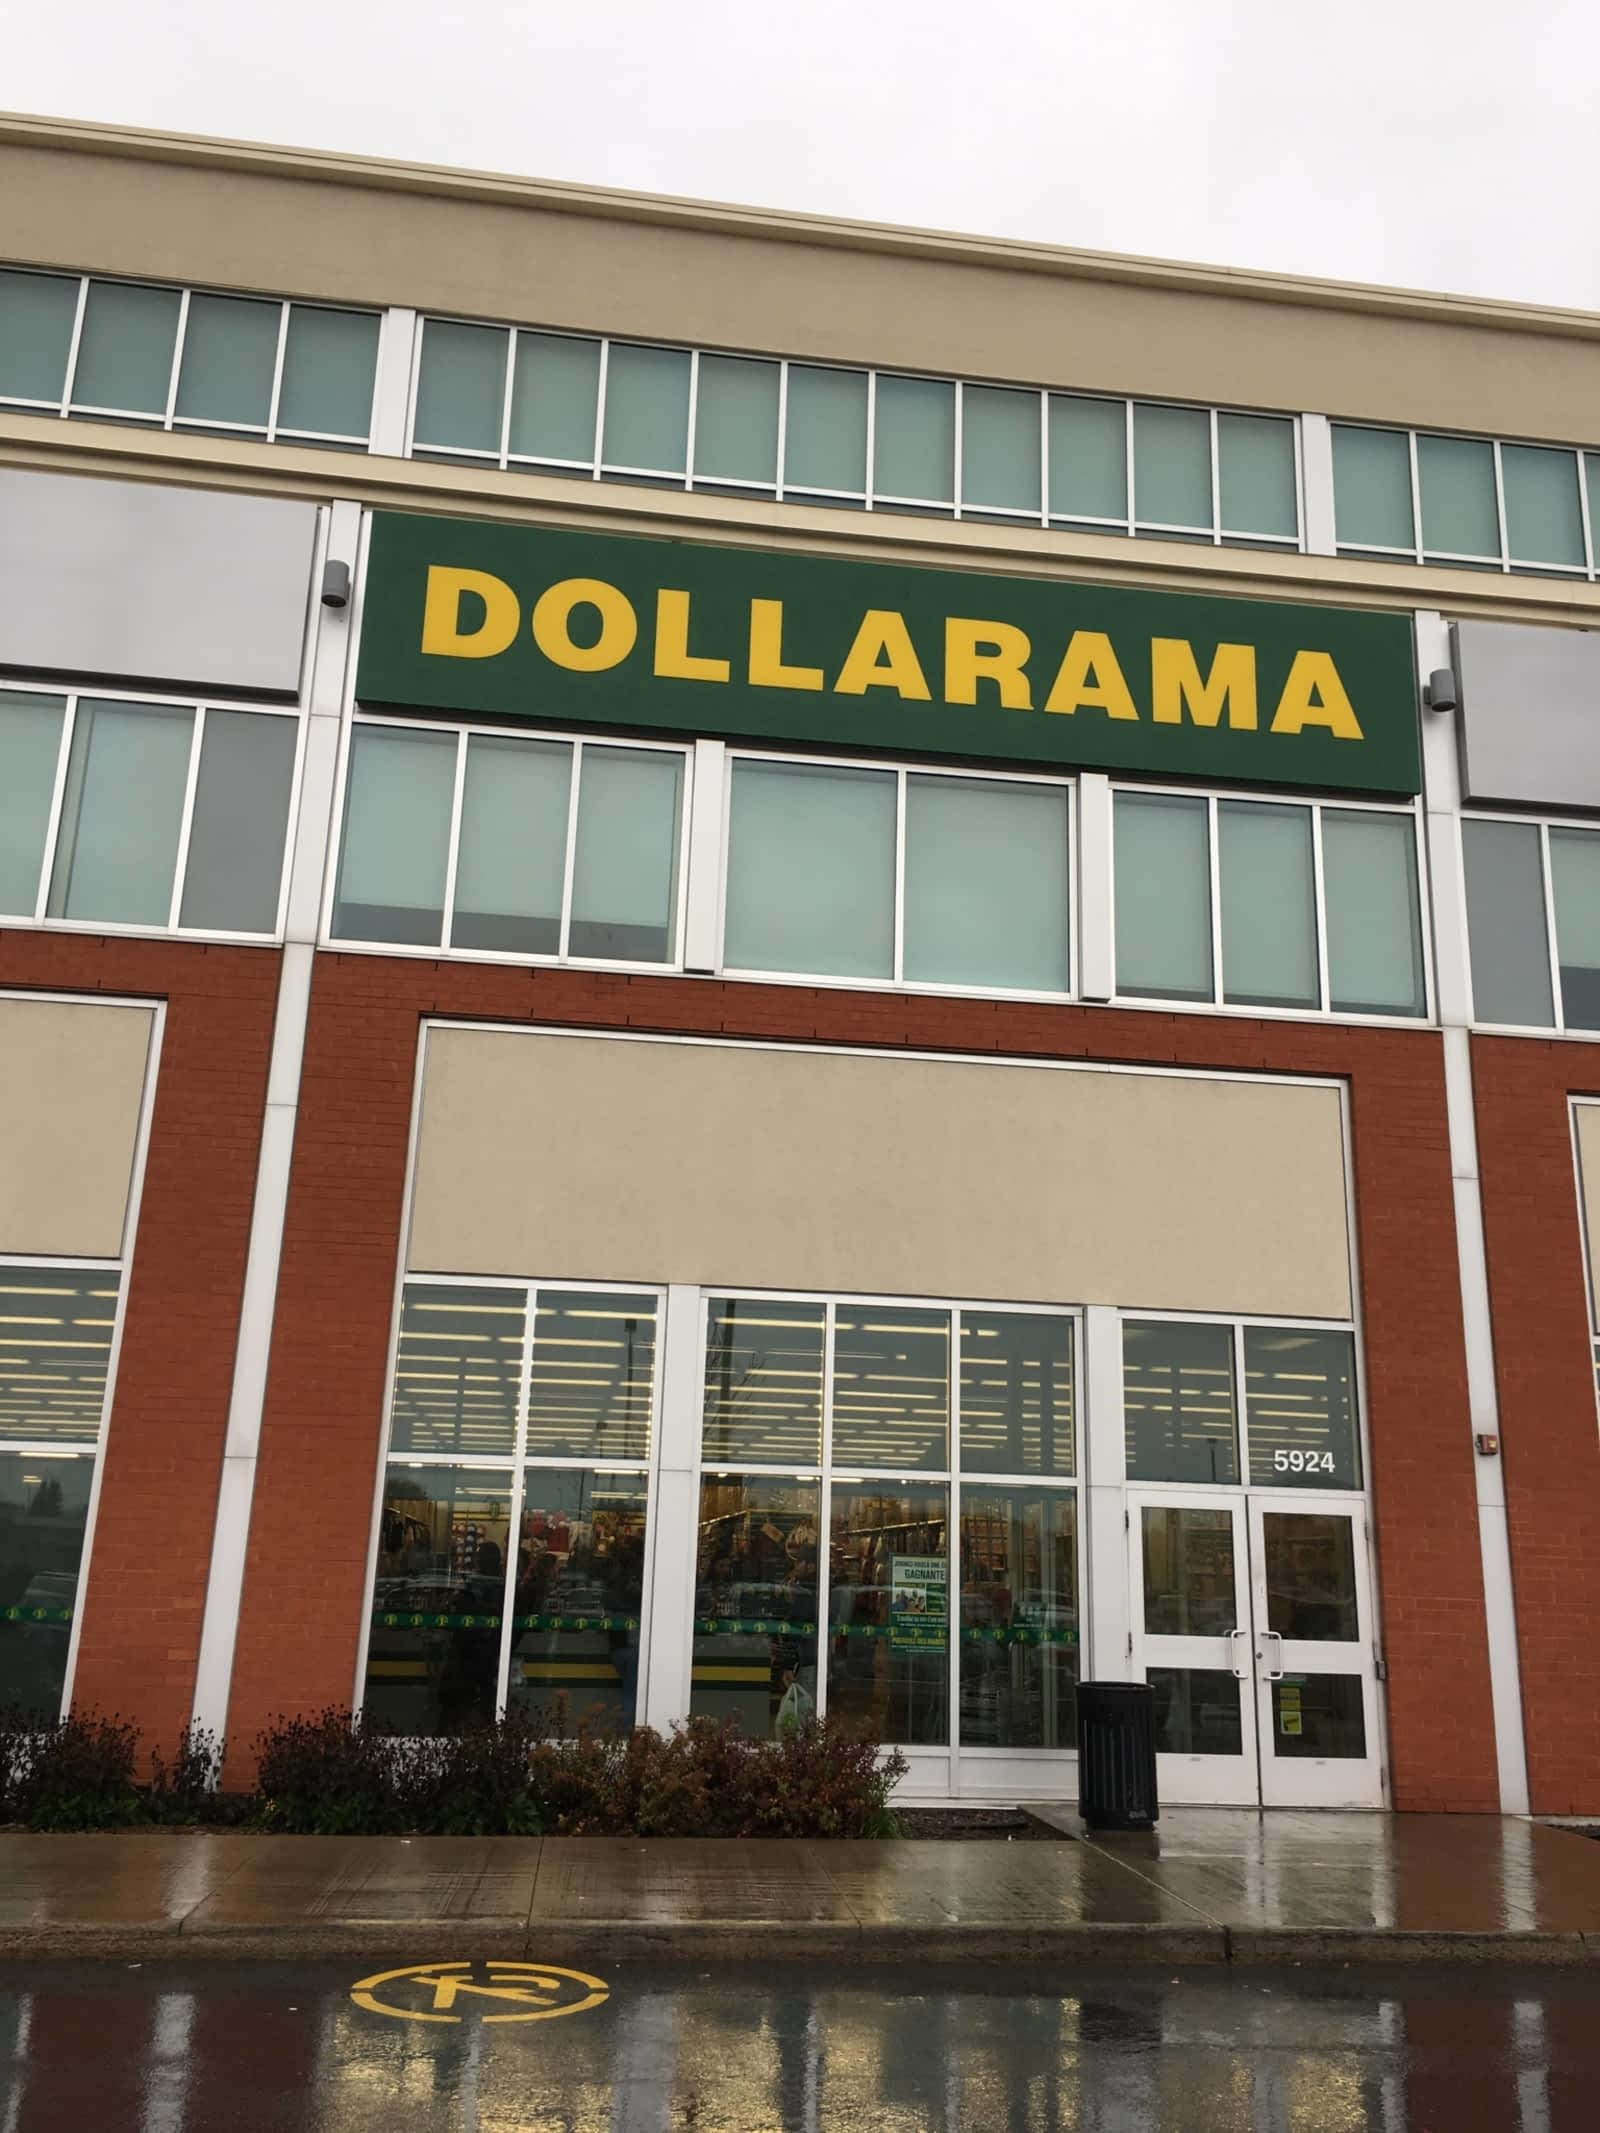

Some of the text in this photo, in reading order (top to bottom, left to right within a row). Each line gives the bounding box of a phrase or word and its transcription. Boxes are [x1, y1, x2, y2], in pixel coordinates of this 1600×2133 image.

[422, 564, 1364, 741] DOLLARAMA
[1274, 1450, 1336, 1472] 5924
[904, 1569, 945, 1581] GAGNANTE
